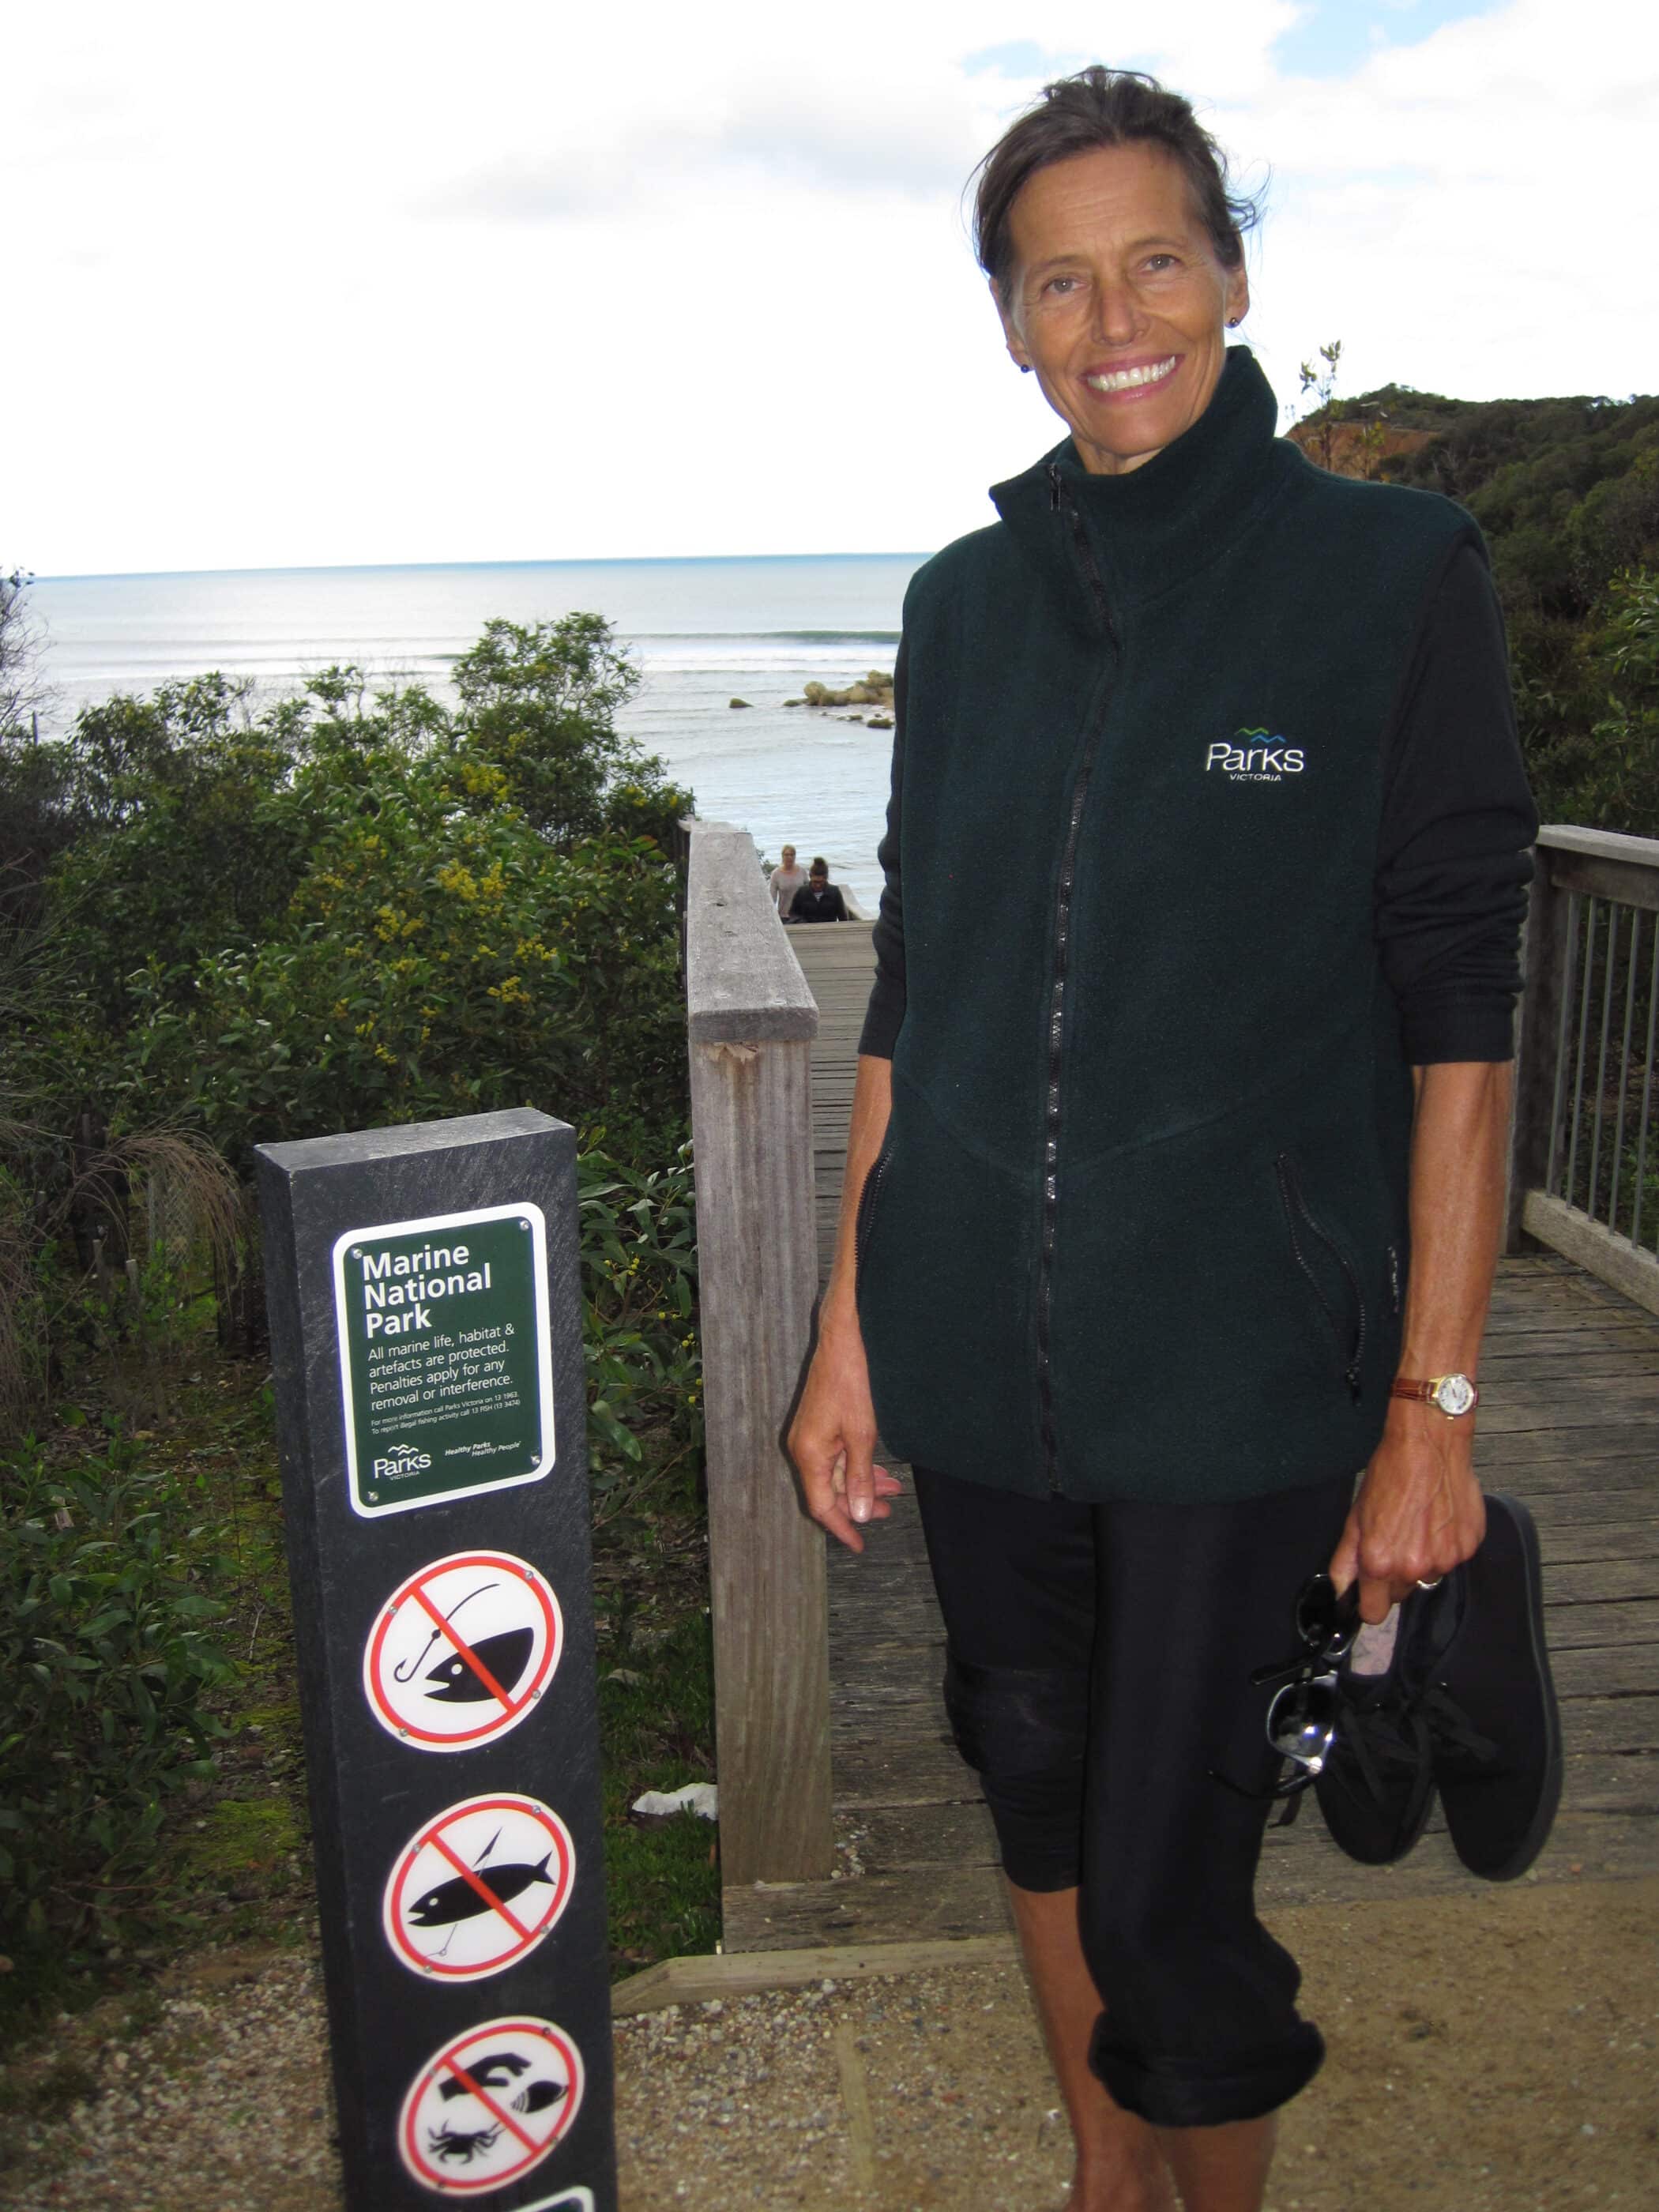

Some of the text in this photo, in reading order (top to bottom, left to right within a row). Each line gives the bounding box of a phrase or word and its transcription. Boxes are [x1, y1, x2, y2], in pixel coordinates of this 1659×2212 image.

[1206, 743, 1304, 772] Parks
[363, 1244, 469, 1281] Marine
[364, 1262, 491, 1310] National
[367, 1303, 432, 1339] Park
[368, 1323, 514, 1361] All marine life, habitat &
[369, 1340, 510, 1378] artefacts are protected.
[370, 1360, 505, 1394] Penalties apply for any
[371, 1375, 513, 1411] removal or interference.
[399, 1409, 433, 1421] information
[434, 1405, 443, 1413] call
[461, 1399, 483, 1408] Victoria
[417, 1416, 438, 1425] fishing
[480, 1405, 493, 1413] FISH
[445, 1441, 491, 1456] Healthy Parks
[472, 1446, 498, 1458] Healthy
[374, 1454, 432, 1479] Parks
[389, 1470, 420, 1480] VICTORIA
